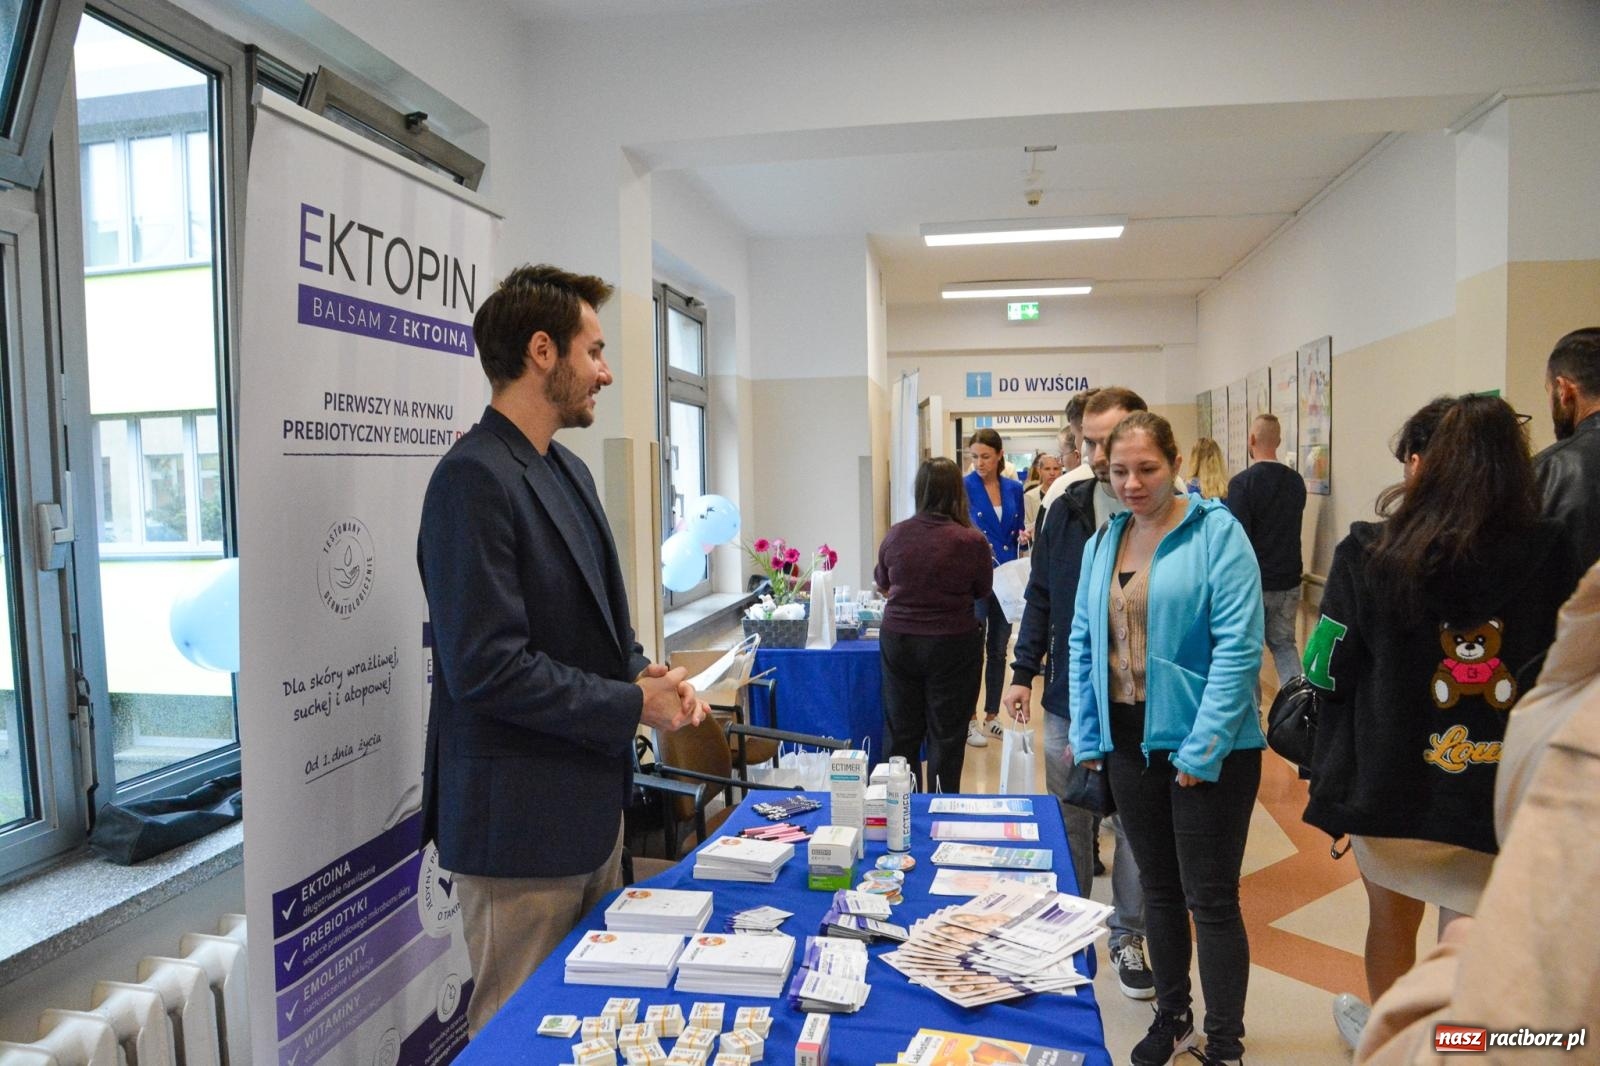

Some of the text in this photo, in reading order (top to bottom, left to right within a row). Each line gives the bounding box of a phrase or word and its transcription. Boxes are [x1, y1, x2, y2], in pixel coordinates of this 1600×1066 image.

[300, 202, 475, 313] EKTOPIN
[313, 297, 468, 351] BALSAM Z EKTOINĄ
[1000, 373, 1089, 392] DO WYJŚCIA
[324, 392, 453, 420] PIERWSZY NA RYNKU
[997, 415, 1010, 424] DO
[283, 420, 391, 443] PREBIOTYCZNY
[394, 427, 453, 445] EMOLIENT
[323, 522, 361, 554] TESTOWANY
[283, 678, 305, 696] Dla
[310, 666, 343, 690] skóry
[294, 673, 391, 721] suchej i atopowej
[305, 757, 319, 775] Od
[333, 744, 354, 760] dnia
[358, 734, 382, 756] życia
[831, 763, 860, 772] ECTIMER
[301, 861, 351, 901] EKTOINA
[303, 897, 368, 951] PREBIOTYKI
[303, 942, 367, 1001] EMOLIENTY
[304, 993, 360, 1048] WITAMINY
